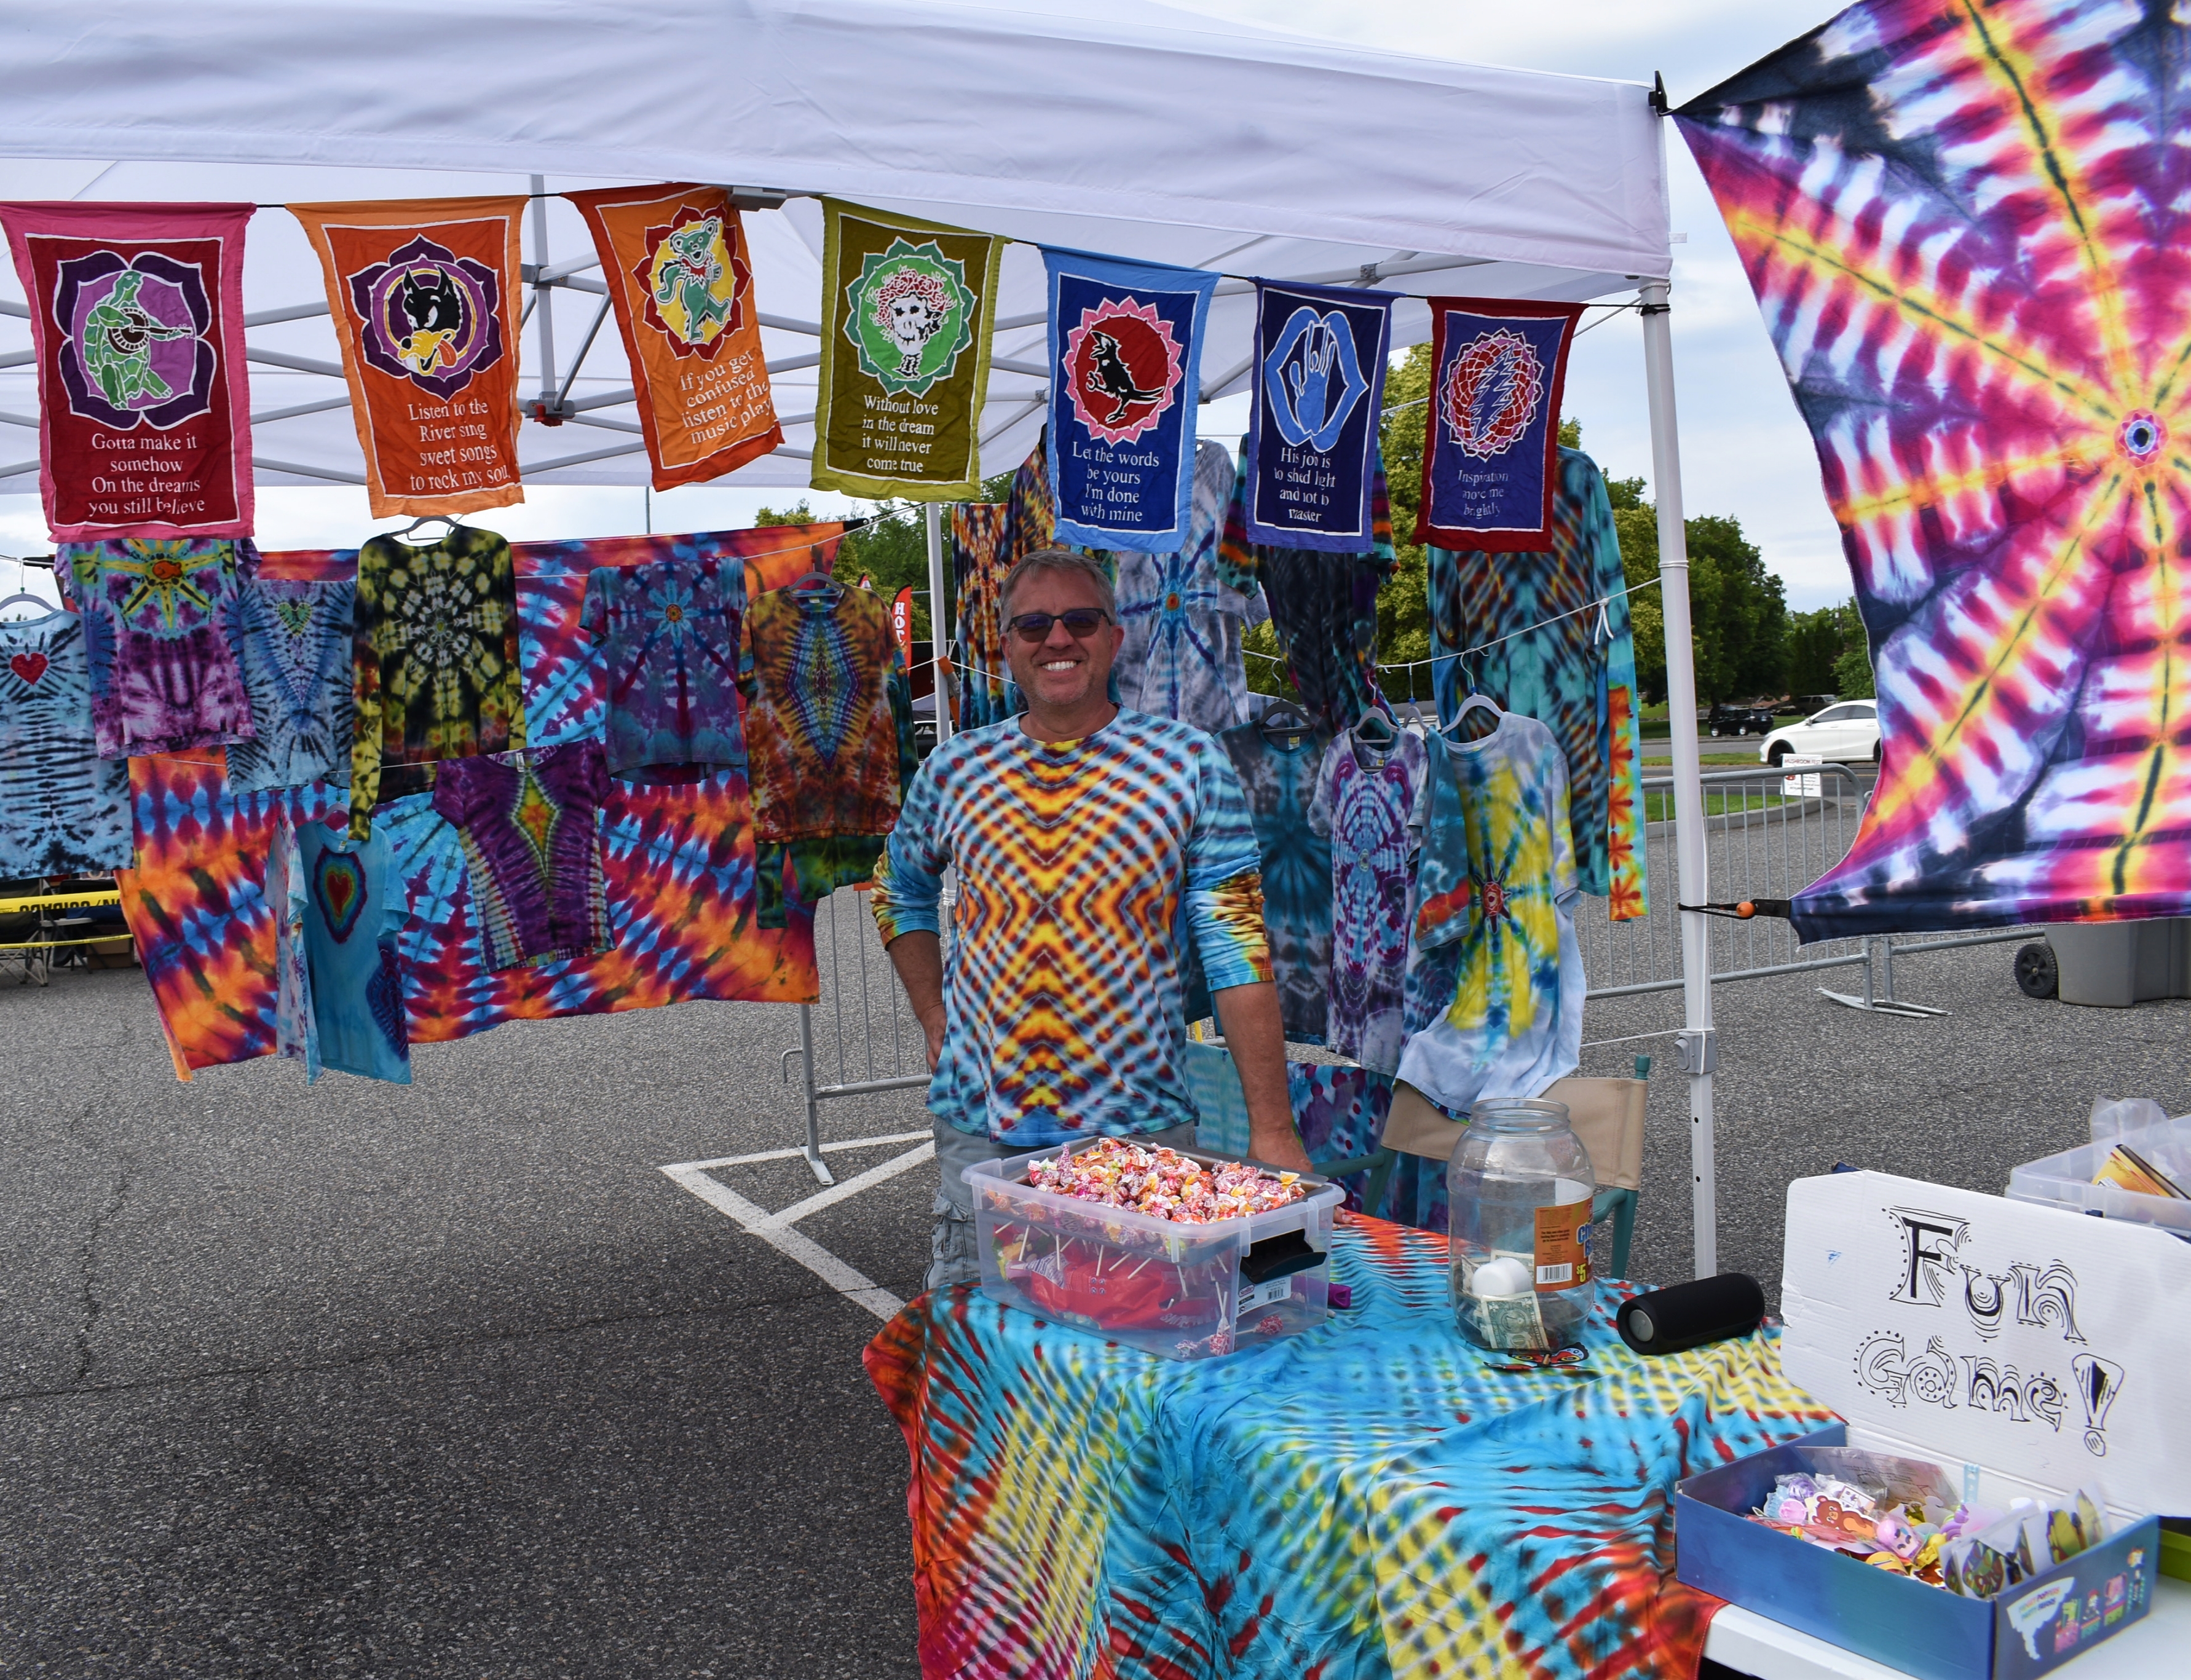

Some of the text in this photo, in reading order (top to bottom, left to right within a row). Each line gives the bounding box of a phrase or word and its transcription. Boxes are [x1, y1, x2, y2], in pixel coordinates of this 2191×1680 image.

[680, 350, 754, 391] If you get
[687, 365, 756, 408] confused
[408, 398, 489, 420] Listen to the
[681, 381, 768, 428] listen to the
[863, 395, 939, 415] Without love
[420, 421, 487, 442] River sing
[691, 398, 771, 444] music play
[862, 414, 934, 435] in the dream
[92, 433, 197, 450] Gotta make it
[862, 433, 932, 454] it will never
[110, 456, 183, 472] somehow
[420, 444, 497, 467] sweet songs
[1072, 441, 1159, 467] Let the words
[1281, 447, 1331, 468] His job is
[867, 457, 923, 473] come true
[1087, 463, 1140, 485] be yours
[92, 477, 200, 492] On the dreams
[410, 473, 425, 491] to
[427, 468, 459, 489] rock
[462, 471, 483, 489] my
[1274, 467, 1336, 491] to shed lght
[1458, 470, 1509, 486] Inspiraton
[1085, 483, 1140, 503] I'm done
[1279, 486, 1300, 501] and
[1462, 488, 1504, 500] moe me
[89, 497, 205, 517] you still believe
[1081, 502, 1143, 521] with mine
[1288, 508, 1322, 523] master
[1464, 502, 1501, 519] brightly
[1882, 1205, 2088, 1346] Fun
